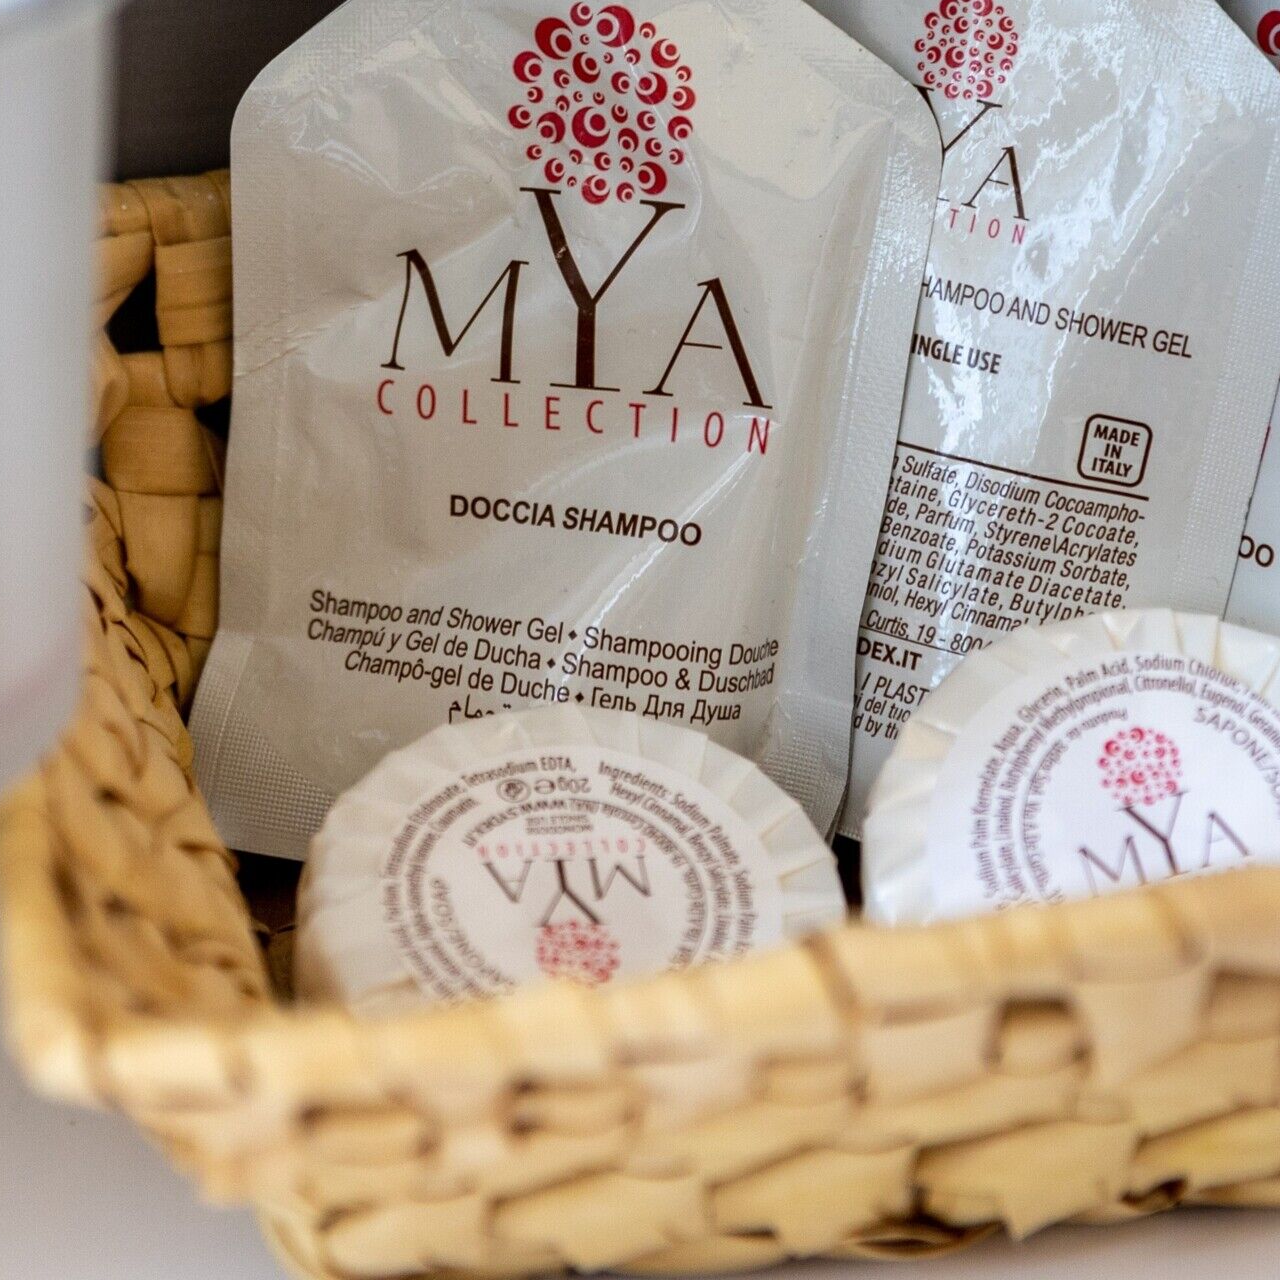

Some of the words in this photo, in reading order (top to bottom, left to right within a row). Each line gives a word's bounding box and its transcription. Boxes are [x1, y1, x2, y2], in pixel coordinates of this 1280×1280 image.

[914, 84, 1030, 221] YA
[380, 187, 772, 409] MYA
[922, 275, 1005, 315] HAMPOO
[1007, 296, 1050, 325] AND
[1055, 308, 1148, 348] SHOWER
[1152, 330, 1192, 358] GEL
[911, 334, 962, 365] INGLE
[967, 348, 1002, 374] USE
[377, 379, 771, 454] COLLECTION
[1094, 425, 1140, 447] MADE
[1091, 458, 1133, 478] ITALY
[1104, 443, 1122, 459] IN
[902, 455, 959, 488] Sulfate,
[965, 471, 1040, 505] Disodium
[1045, 490, 1145, 523] Cocoampho-
[450, 495, 555, 526] DOCCIA
[562, 507, 702, 546] SHAMPOO
[915, 503, 978, 538] Parfum,
[949, 489, 1059, 530] Glycereth-2
[1062, 516, 1139, 549] Cocoate,
[878, 538, 922, 565] dium
[926, 551, 1024, 590] Glutamate
[1028, 575, 1126, 610] Diacetate.
[880, 516, 959, 556] Benzoate,
[965, 538, 1056, 575] Potassium
[1060, 560, 1131, 592] Sorbate,
[904, 589, 948, 618] Hexyl
[951, 601, 1029, 633] Cinnama
[906, 567, 1003, 611] Salicylate,
[1009, 593, 1095, 621] Butylph
[309, 589, 402, 623] Shampoo
[406, 606, 444, 626] and
[447, 607, 521, 636] Shower
[527, 618, 563, 643] Gel
[584, 626, 722, 668] Shampooing
[728, 639, 779, 666] Douche
[866, 609, 909, 640] Curtis,
[917, 623, 937, 644] 19
[307, 619, 385, 650] Champú
[387, 632, 402, 653] y
[406, 630, 440, 653] Gel
[443, 635, 468, 657] de
[474, 639, 540, 669] Ducha
[562, 652, 667, 689] Shampoo
[675, 668, 690, 690] &
[698, 663, 774, 693] Duschbad
[344, 650, 462, 689] Champô-gel
[468, 668, 493, 691] de
[501, 672, 569, 703] Duche
[856, 636, 922, 671] DEX.IT
[1135, 655, 1185, 671] Sodium
[591, 687, 636, 712] Гель
[643, 695, 684, 720] Для
[690, 699, 741, 726] Душа
[865, 697, 888, 717] del
[873, 675, 931, 707] PLAST
[865, 715, 883, 738] by
[672, 793, 710, 829] Sodium
[1077, 790, 1250, 898] MYA
[483, 858, 651, 927] MYA
